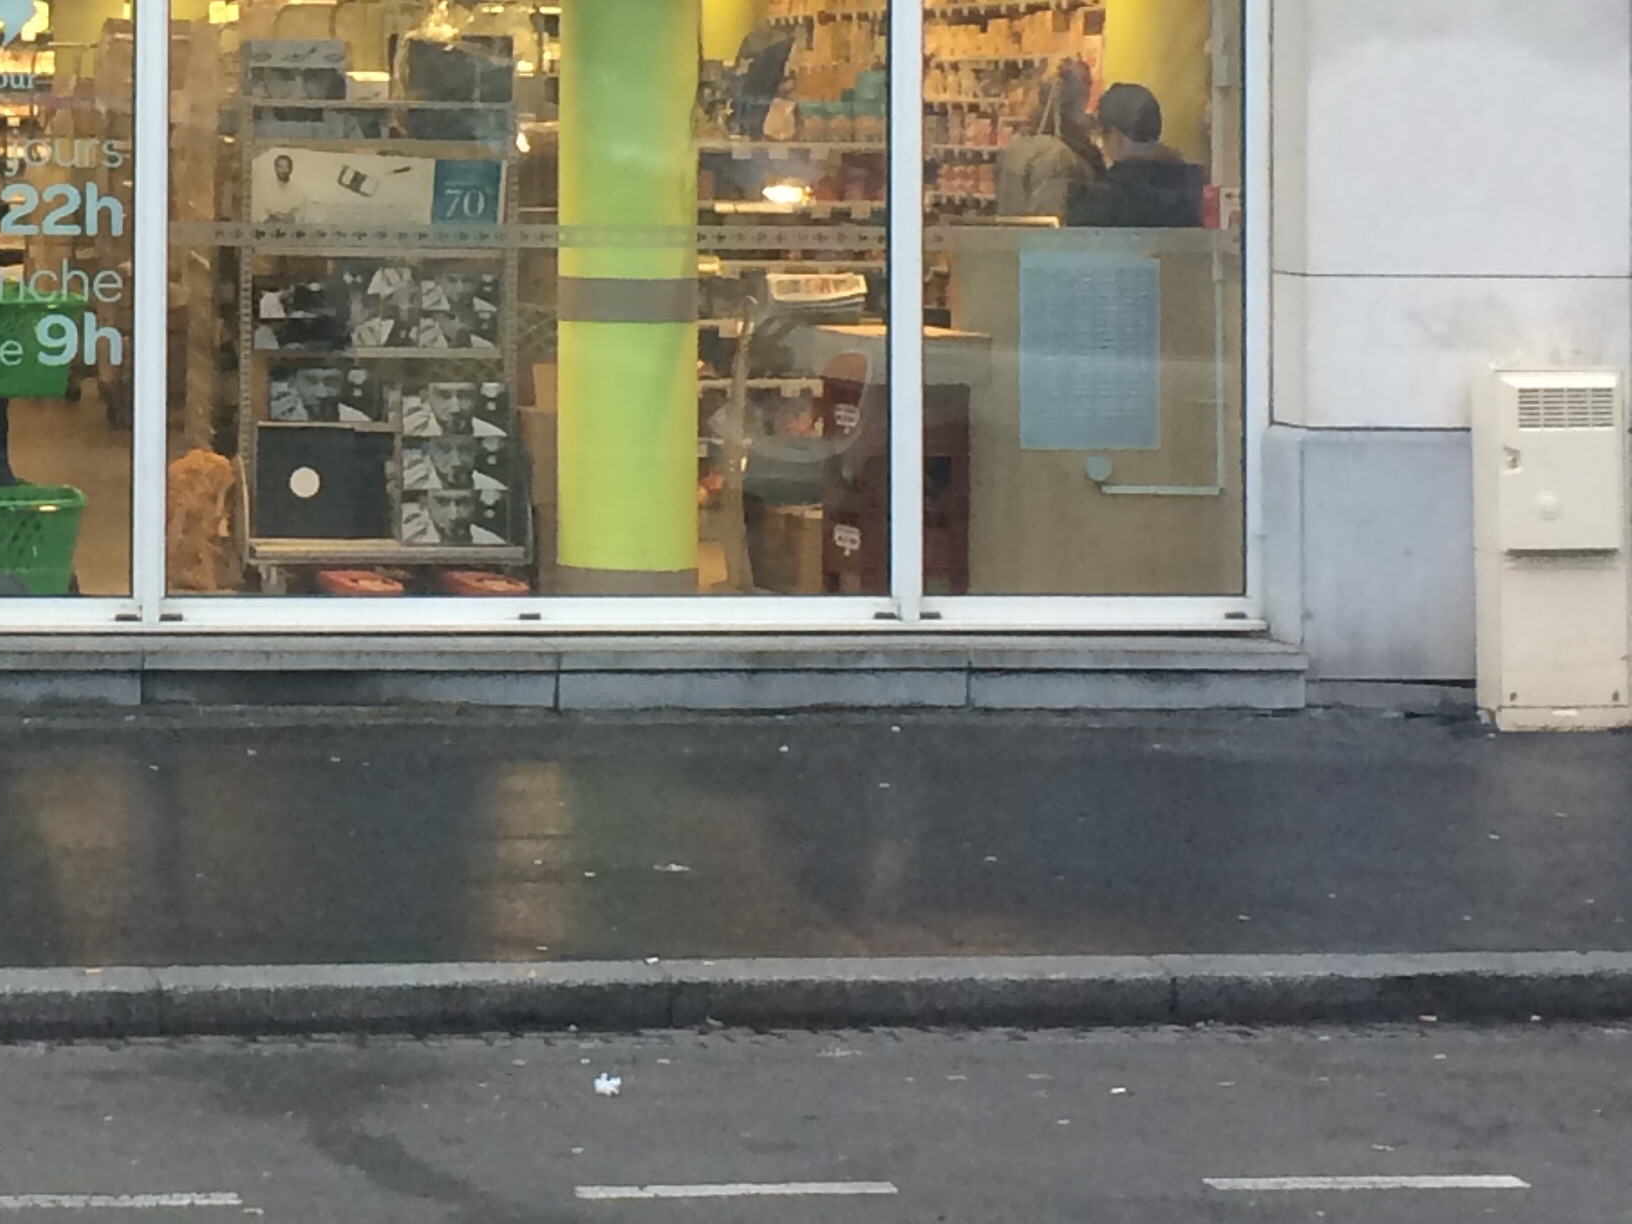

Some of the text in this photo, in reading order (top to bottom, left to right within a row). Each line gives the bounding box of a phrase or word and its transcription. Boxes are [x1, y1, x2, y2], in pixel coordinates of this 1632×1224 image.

[4, 130, 123, 176] jours
[0, 182, 123, 236] 22h
[444, 188, 485, 218] 70
[36, 312, 122, 366] 9h
